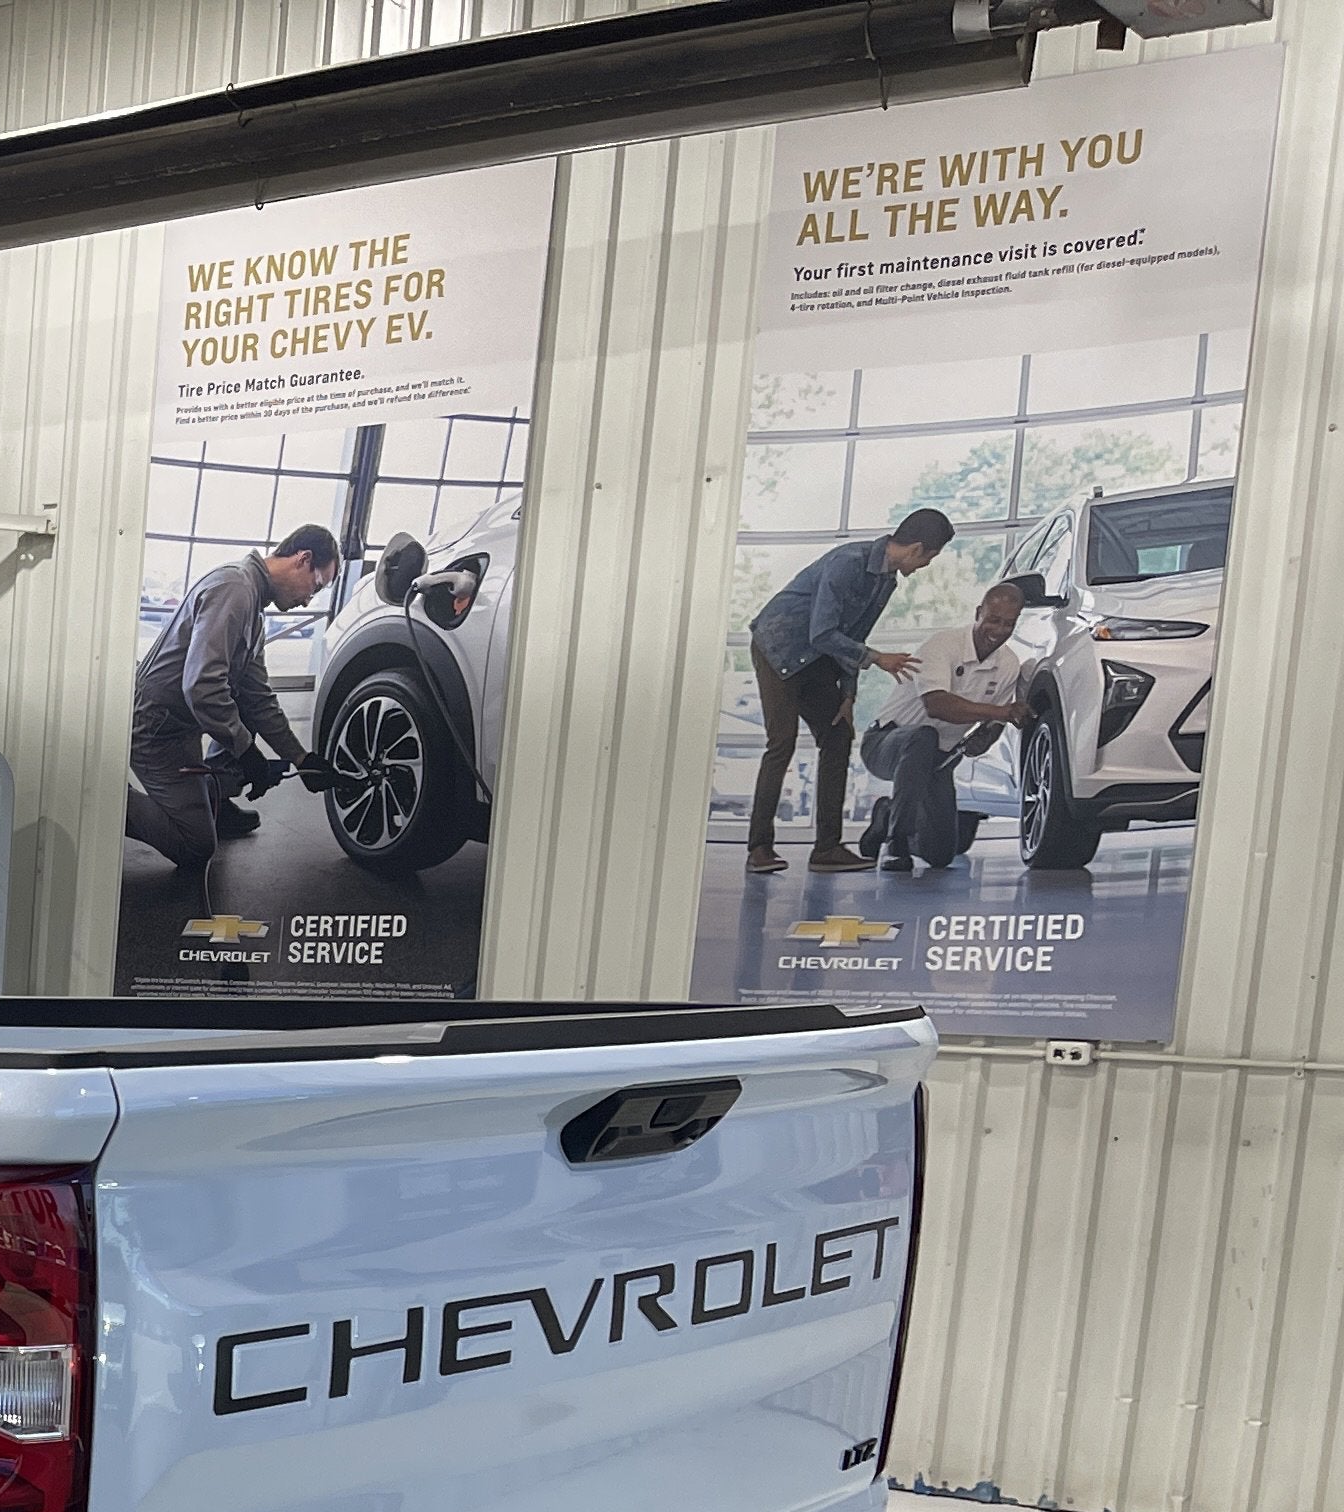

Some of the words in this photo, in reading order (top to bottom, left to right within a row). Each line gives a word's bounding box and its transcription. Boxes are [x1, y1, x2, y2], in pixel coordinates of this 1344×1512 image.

[803, 158, 926, 204] WE'RE
[939, 143, 1045, 188] WITH
[1059, 129, 1144, 173] YOU
[796, 208, 869, 246] ALL
[883, 198, 960, 238] THE
[973, 184, 1069, 228] WAY.
[188, 260, 235, 293] WE
[244, 244, 339, 287] KNOW
[349, 233, 411, 271] THE
[790, 290, 830, 301] Includes:
[832, 288, 843, 298] oil
[844, 286, 862, 297] and
[863, 285, 874, 295] oil
[875, 283, 899, 294] filter
[899, 280, 936, 293] change,
[937, 277, 965, 288] diesel
[966, 273, 1003, 286] exhaust
[1004, 270, 1026, 281] fluid
[1028, 267, 1050, 278] tank
[1051, 264, 1075, 275] refill
[1076, 262, 1094, 275] (for
[1096, 251, 1176, 270] diesel-equipped
[1177, 245, 1221, 260] models),
[793, 266, 832, 282] Your
[836, 262, 875, 279] first
[879, 251, 994, 275] maintenance
[999, 243, 1038, 262] visit
[1042, 241, 1058, 258] is
[184, 292, 275, 331] RIGHT
[284, 279, 373, 319] TIRES
[384, 268, 446, 306] FOR
[790, 302, 815, 312] 4-tire
[816, 299, 855, 312] rotation,
[856, 297, 873, 308] and
[874, 293, 925, 307] Multi-Point
[926, 290, 960, 302] Vehicle
[961, 285, 1013, 299] Inspection.
[182, 332, 259, 367] YOUR
[270, 317, 377, 359] CHEVY
[385, 309, 433, 345] EV.
[175, 405, 202, 415] Provide
[213, 402, 229, 412] with
[235, 401, 259, 411] better
[259, 398, 285, 410] eligible
[286, 396, 305, 406] price
[306, 395, 315, 403] at
[316, 392, 329, 402] the
[329, 391, 346, 400] time
[347, 389, 356, 399] of
[357, 385, 394, 398] purchase,
[395, 382, 410, 392] and
[430, 377, 455, 388] match
[177, 383, 203, 398] Tire
[207, 380, 241, 396] Price
[245, 374, 285, 393] Match
[289, 368, 365, 388] Guarantee.
[175, 416, 190, 425] Find
[197, 415, 219, 424] better
[220, 412, 239, 424] price
[240, 411, 262, 420] within
[273, 408, 291, 418] days
[292, 405, 300, 415] of
[301, 404, 313, 414] the
[314, 401, 351, 414] purchase,
[351, 399, 366, 409] and
[385, 394, 412, 404] refund
[413, 391, 426, 401] the
[290, 915, 408, 938] CERTIFIED
[927, 913, 1085, 941] CERTIFIED
[178, 949, 272, 963] CHEVROLET
[287, 941, 385, 965] SERVICE
[777, 955, 903, 971] CHEVROLET
[924, 945, 1054, 972] SERVICE
[212, 1216, 900, 1416] CHEVROLET
[840, 1436, 878, 1472] LTZ
